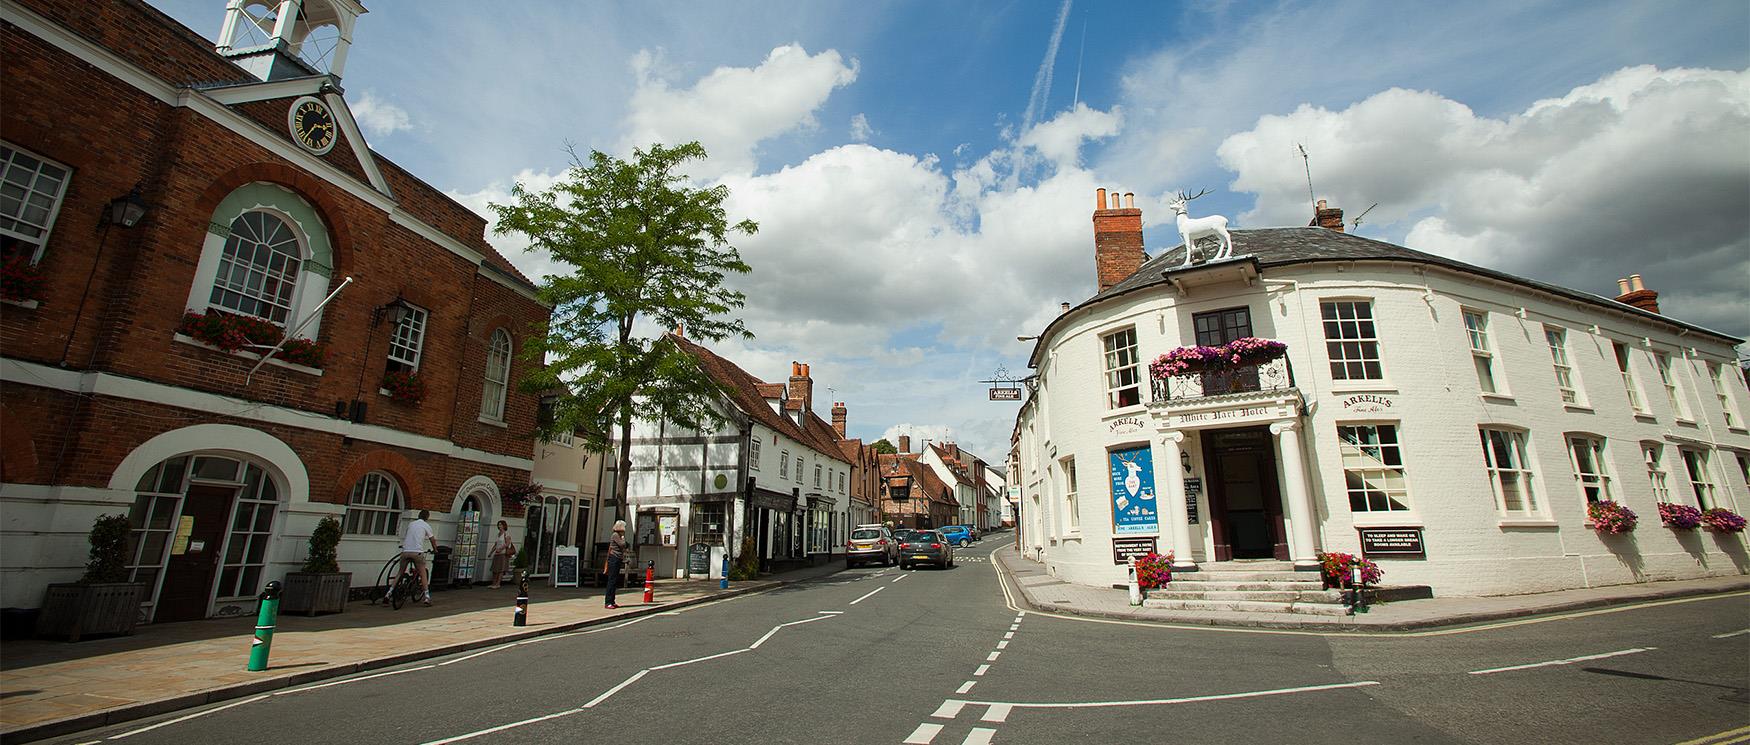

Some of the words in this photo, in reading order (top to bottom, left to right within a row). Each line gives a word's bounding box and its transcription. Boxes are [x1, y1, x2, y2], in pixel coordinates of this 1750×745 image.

[1343, 395, 1392, 408] ARKELL'S
[1180, 413, 1207, 422] White
[1212, 411, 1235, 419] Hart
[1240, 407, 1268, 416] Hotel
